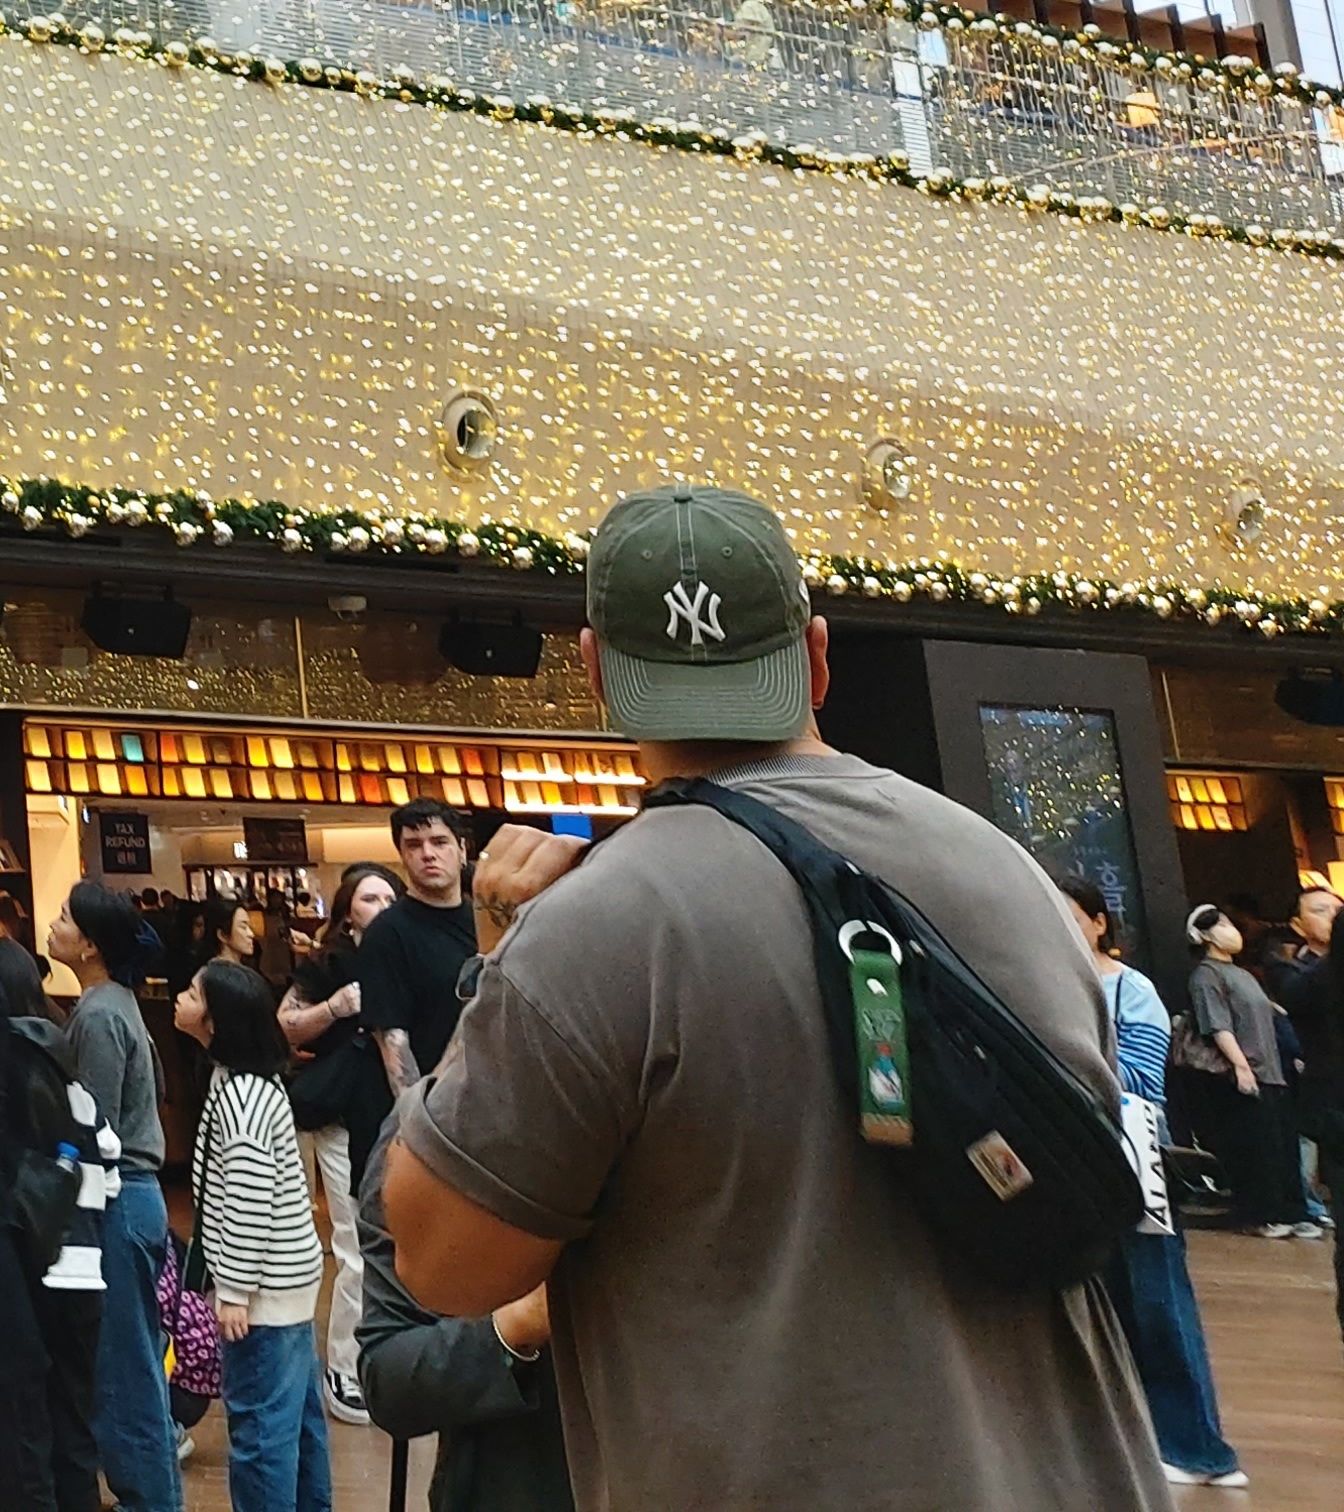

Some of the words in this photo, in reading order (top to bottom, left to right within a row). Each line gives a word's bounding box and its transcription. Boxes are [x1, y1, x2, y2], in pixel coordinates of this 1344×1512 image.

[663, 580, 726, 645] NY
[115, 823, 135, 835] TAX
[105, 835, 146, 849] REFUND
